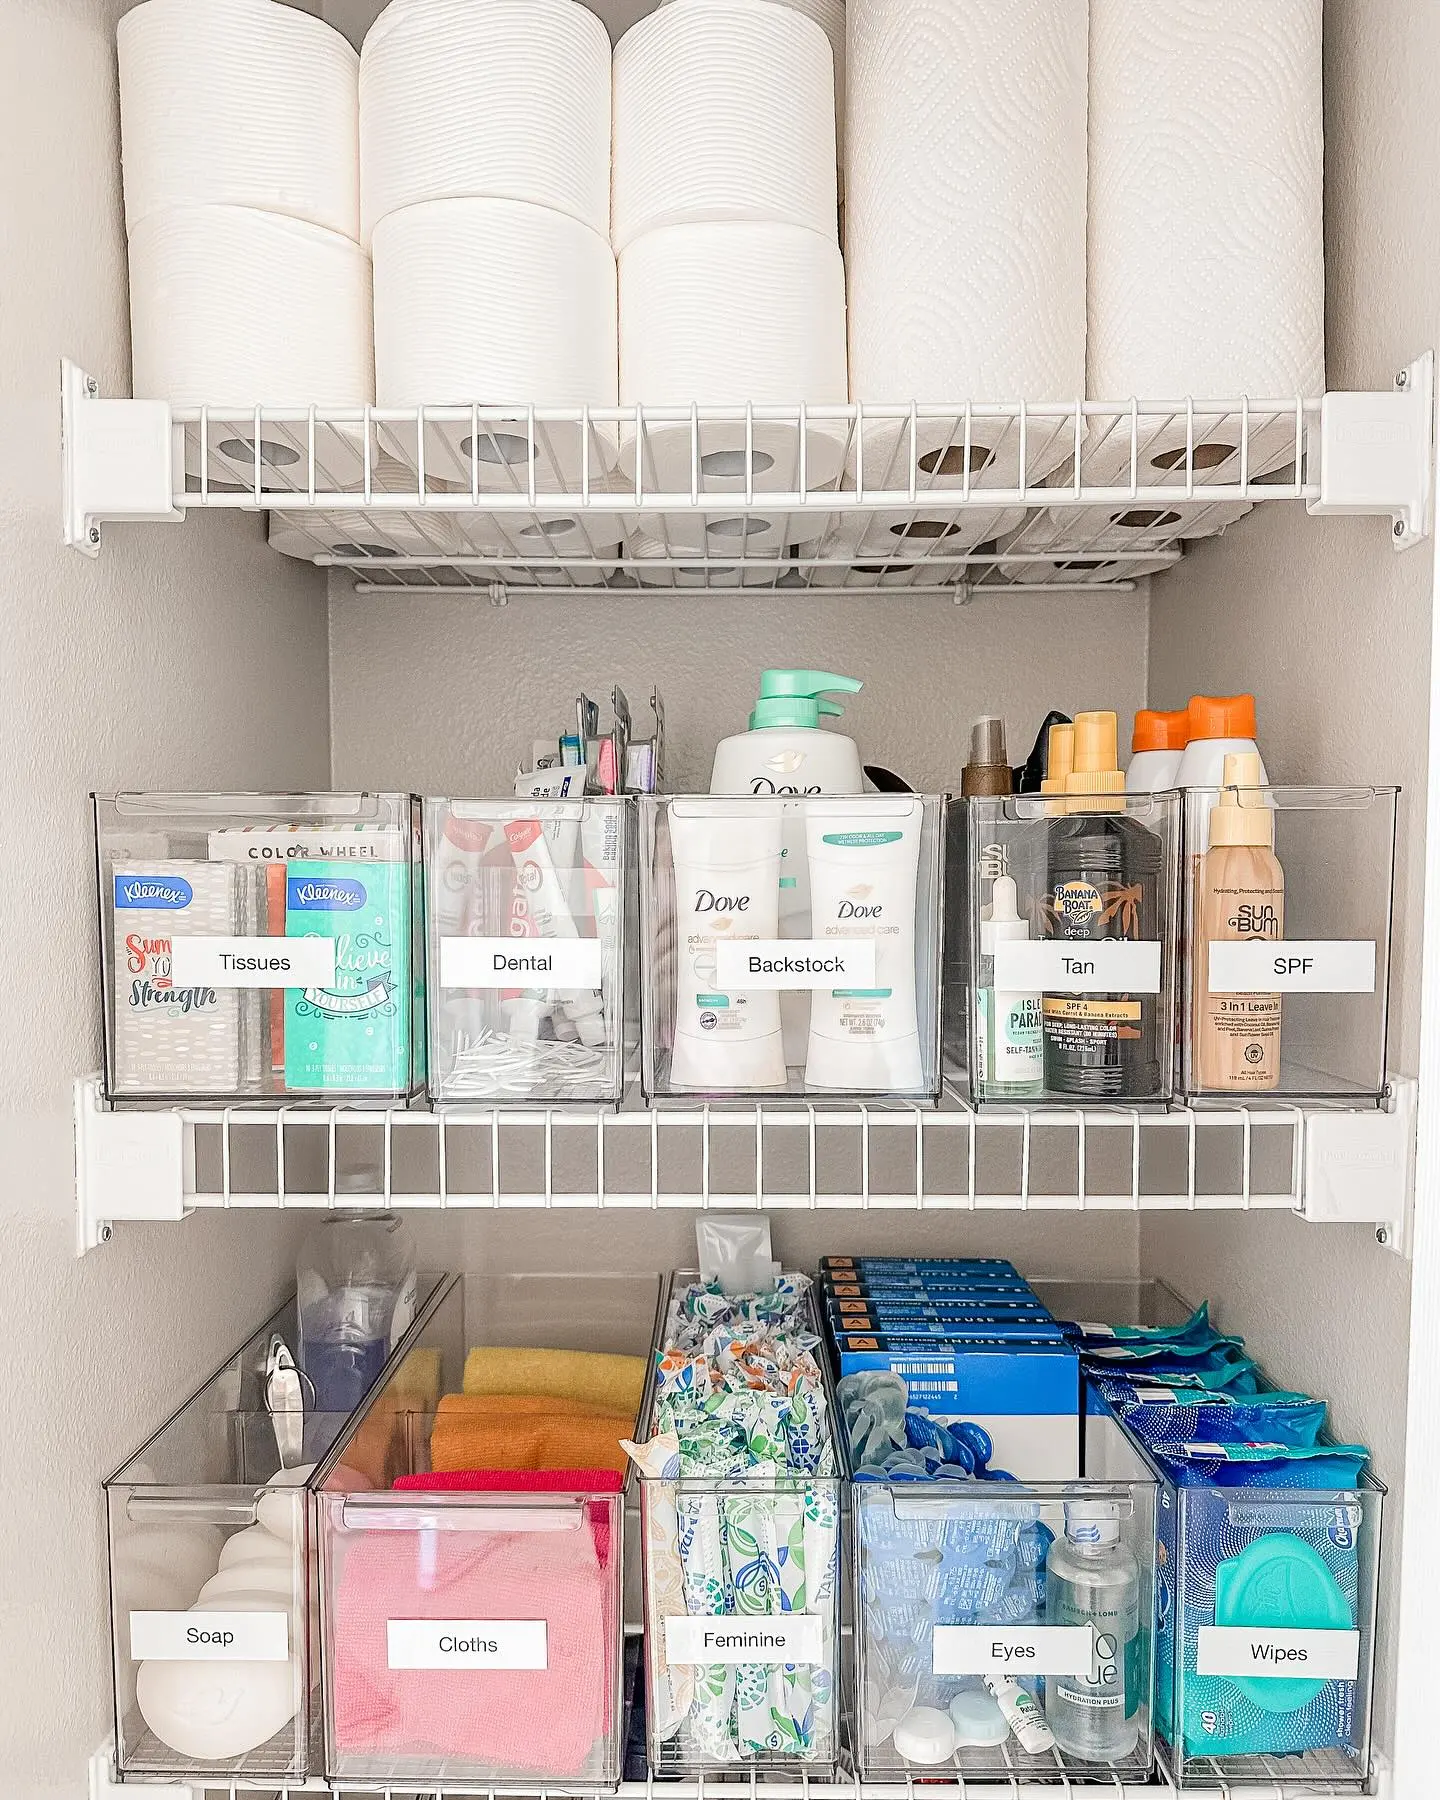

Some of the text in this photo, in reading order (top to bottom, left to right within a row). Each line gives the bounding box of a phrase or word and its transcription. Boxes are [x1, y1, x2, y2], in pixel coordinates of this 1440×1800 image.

[248, 846, 379, 859] COLOR WHEEL
[123, 882, 183, 904] Kleenex
[296, 882, 356, 905] Kleenex
[694, 889, 750, 913] Dove
[1055, 886, 1098, 901] BANANA
[837, 900, 883, 919] Dove
[1063, 899, 1091, 915] BOAT
[1239, 905, 1274, 919] SUN
[877, 925, 900, 936] care
[1064, 926, 1090, 937] deep
[1228, 917, 1279, 939] BUM
[126, 934, 172, 974] Sum
[334, 933, 391, 972] lieve
[151, 956, 172, 977] YO
[219, 954, 291, 972] Tissues
[492, 954, 552, 971] Dental
[749, 956, 845, 973] Backstock
[1061, 957, 1095, 975] Tan
[1273, 958, 1314, 975] SPF
[128, 979, 217, 1013] Strength
[312, 988, 383, 1012] YOURSELF
[1066, 1002, 1088, 1011] SPF 4
[1221, 1002, 1227, 1011] 3
[1229, 1002, 1239, 1011] In
[1240, 1002, 1245, 1011] 1
[1248, 1002, 1273, 1011] Leave
[1063, 1023, 1099, 1031] LONG-LASTING
[1162, 1490, 1171, 1509] 40
[186, 1627, 234, 1647] Soap
[438, 1636, 498, 1653] Cloths
[703, 1631, 787, 1649] Feminine
[991, 1642, 1036, 1660] Eyes
[1250, 1643, 1308, 1664] Wipes
[1085, 1665, 1118, 1685] ue
[1064, 1691, 1119, 1705] HYDRATION PLUS
[1335, 1682, 1345, 1738] shower fresh
[1201, 1710, 1217, 1735] 40
[1344, 1712, 1352, 1737] clean
[771, 1735, 779, 1748] S
